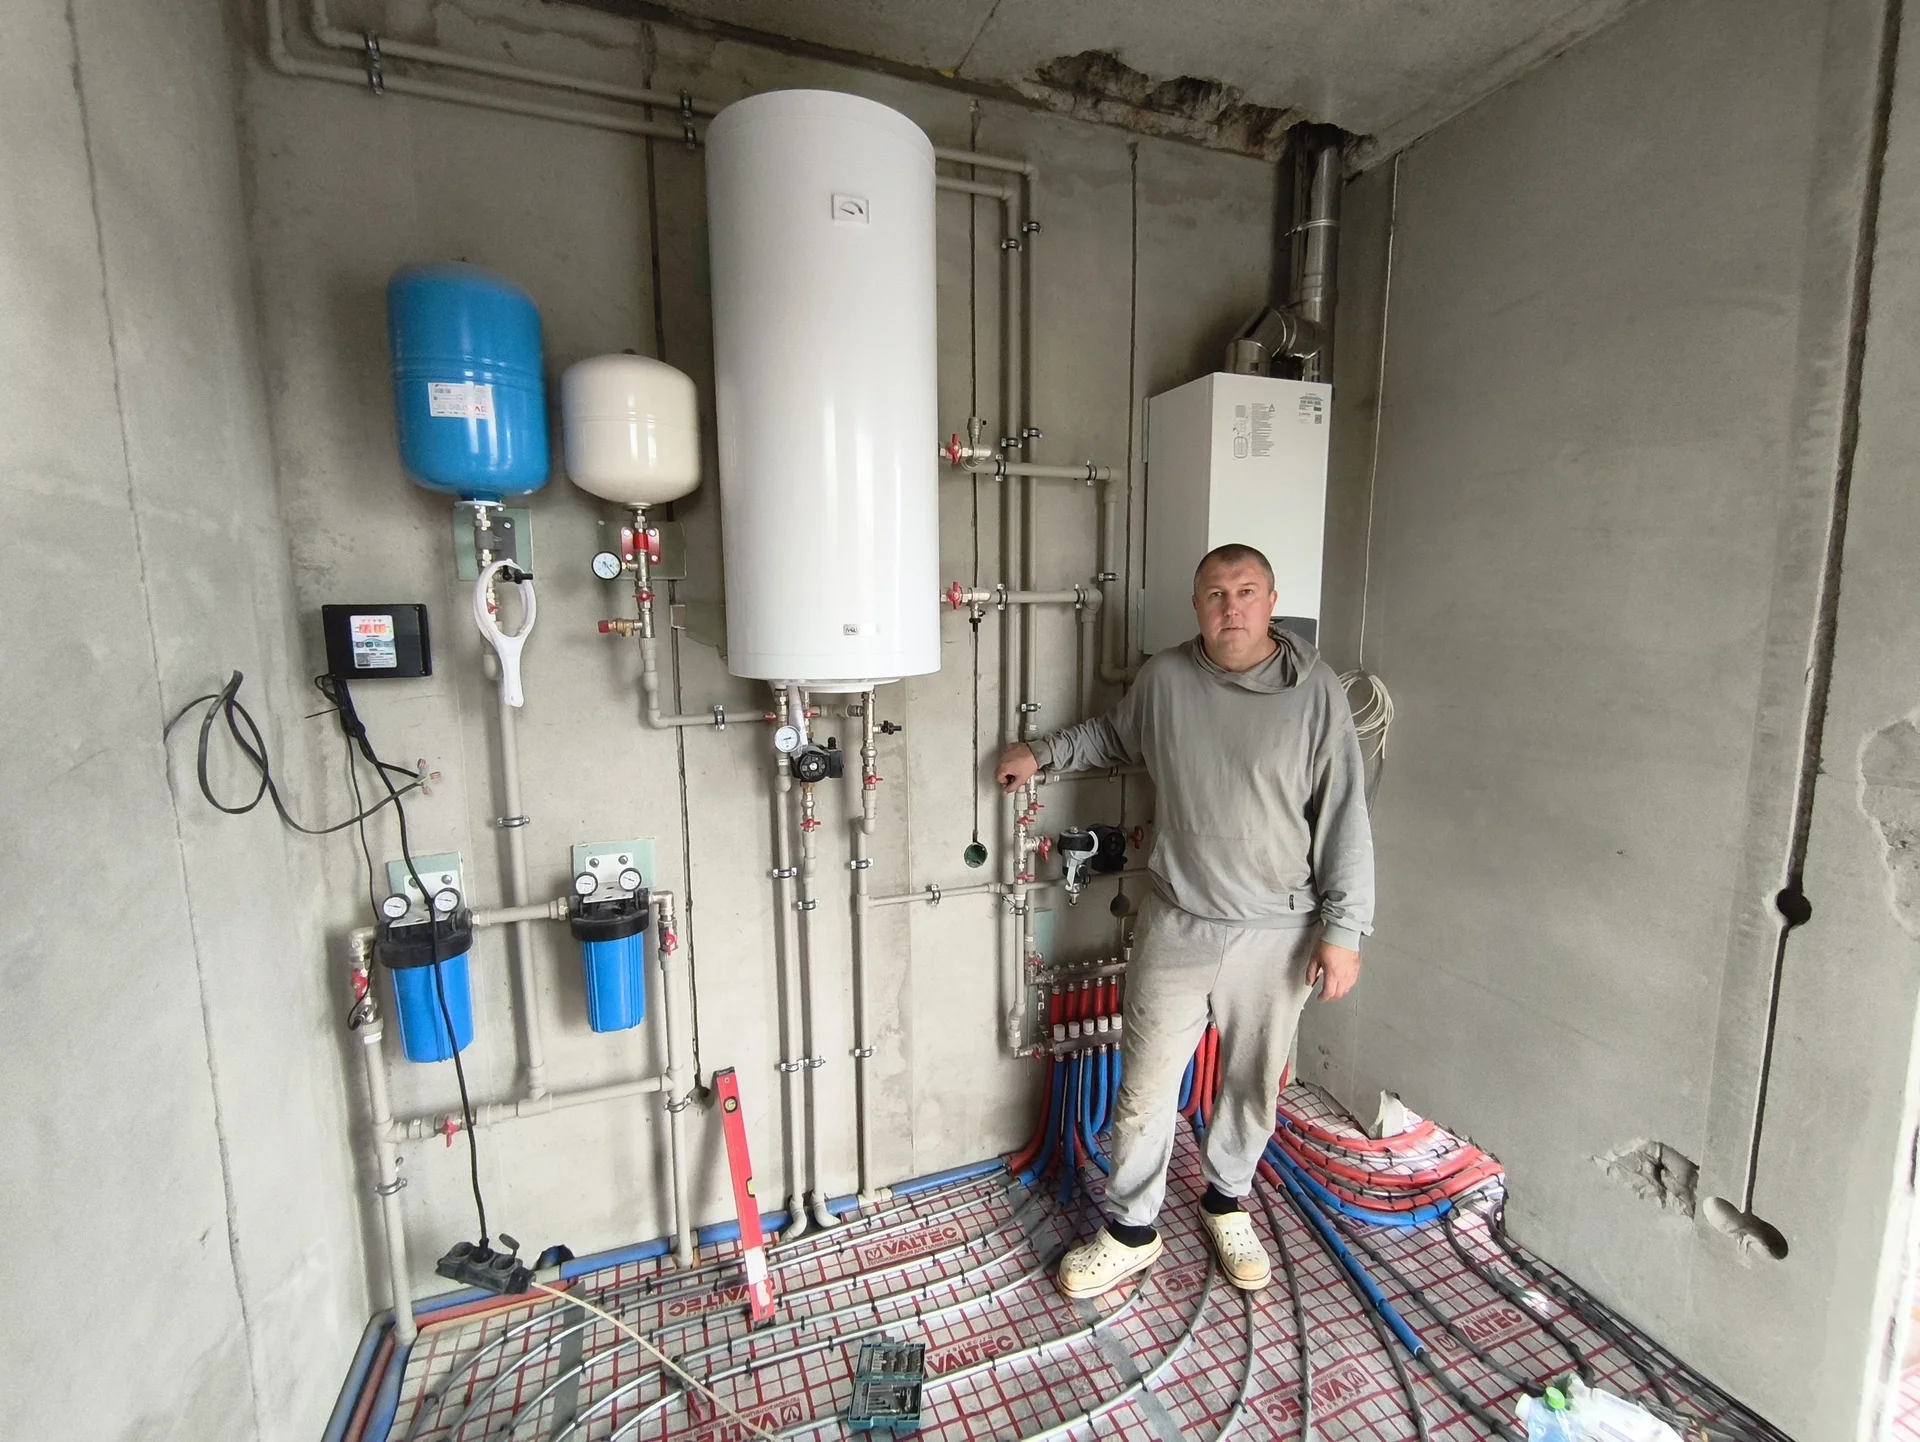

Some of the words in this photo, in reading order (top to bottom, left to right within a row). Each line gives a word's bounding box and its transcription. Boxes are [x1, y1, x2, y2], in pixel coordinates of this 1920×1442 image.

[882, 1227, 957, 1255] VALTEC
[1460, 1308, 1523, 1343] ALTEC
[927, 1335, 1014, 1375] VALTEC
